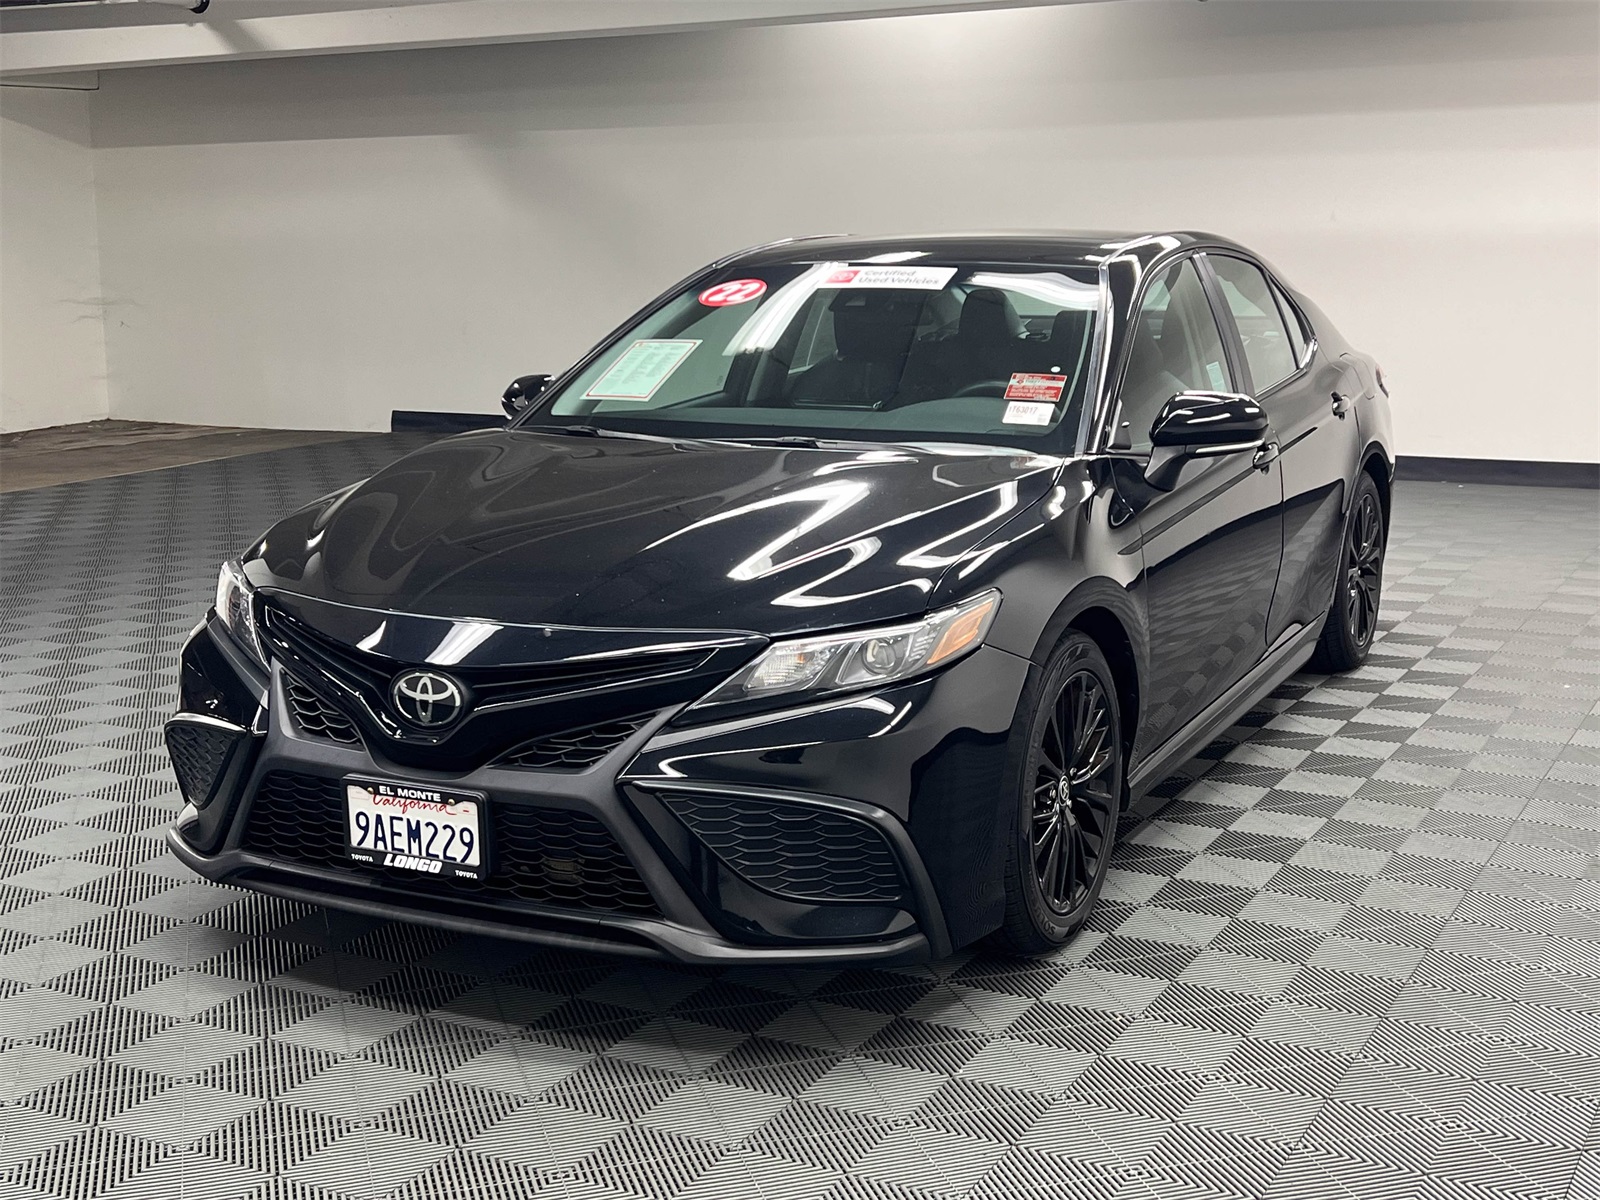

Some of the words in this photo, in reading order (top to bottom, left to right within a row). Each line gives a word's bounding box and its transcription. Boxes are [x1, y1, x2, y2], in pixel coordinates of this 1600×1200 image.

[858, 276, 888, 284] Used
[891, 276, 940, 285] Vehicles
[864, 269, 917, 277] Certified
[707, 282, 761, 302] 22
[378, 785, 394, 795] EL
[397, 788, 441, 802] MONTE
[372, 793, 457, 815] California
[355, 810, 474, 864] 9AEM229
[351, 853, 374, 863] TOYOTA
[383, 853, 443, 874] LONGO
[455, 869, 478, 879] TOYOTA
